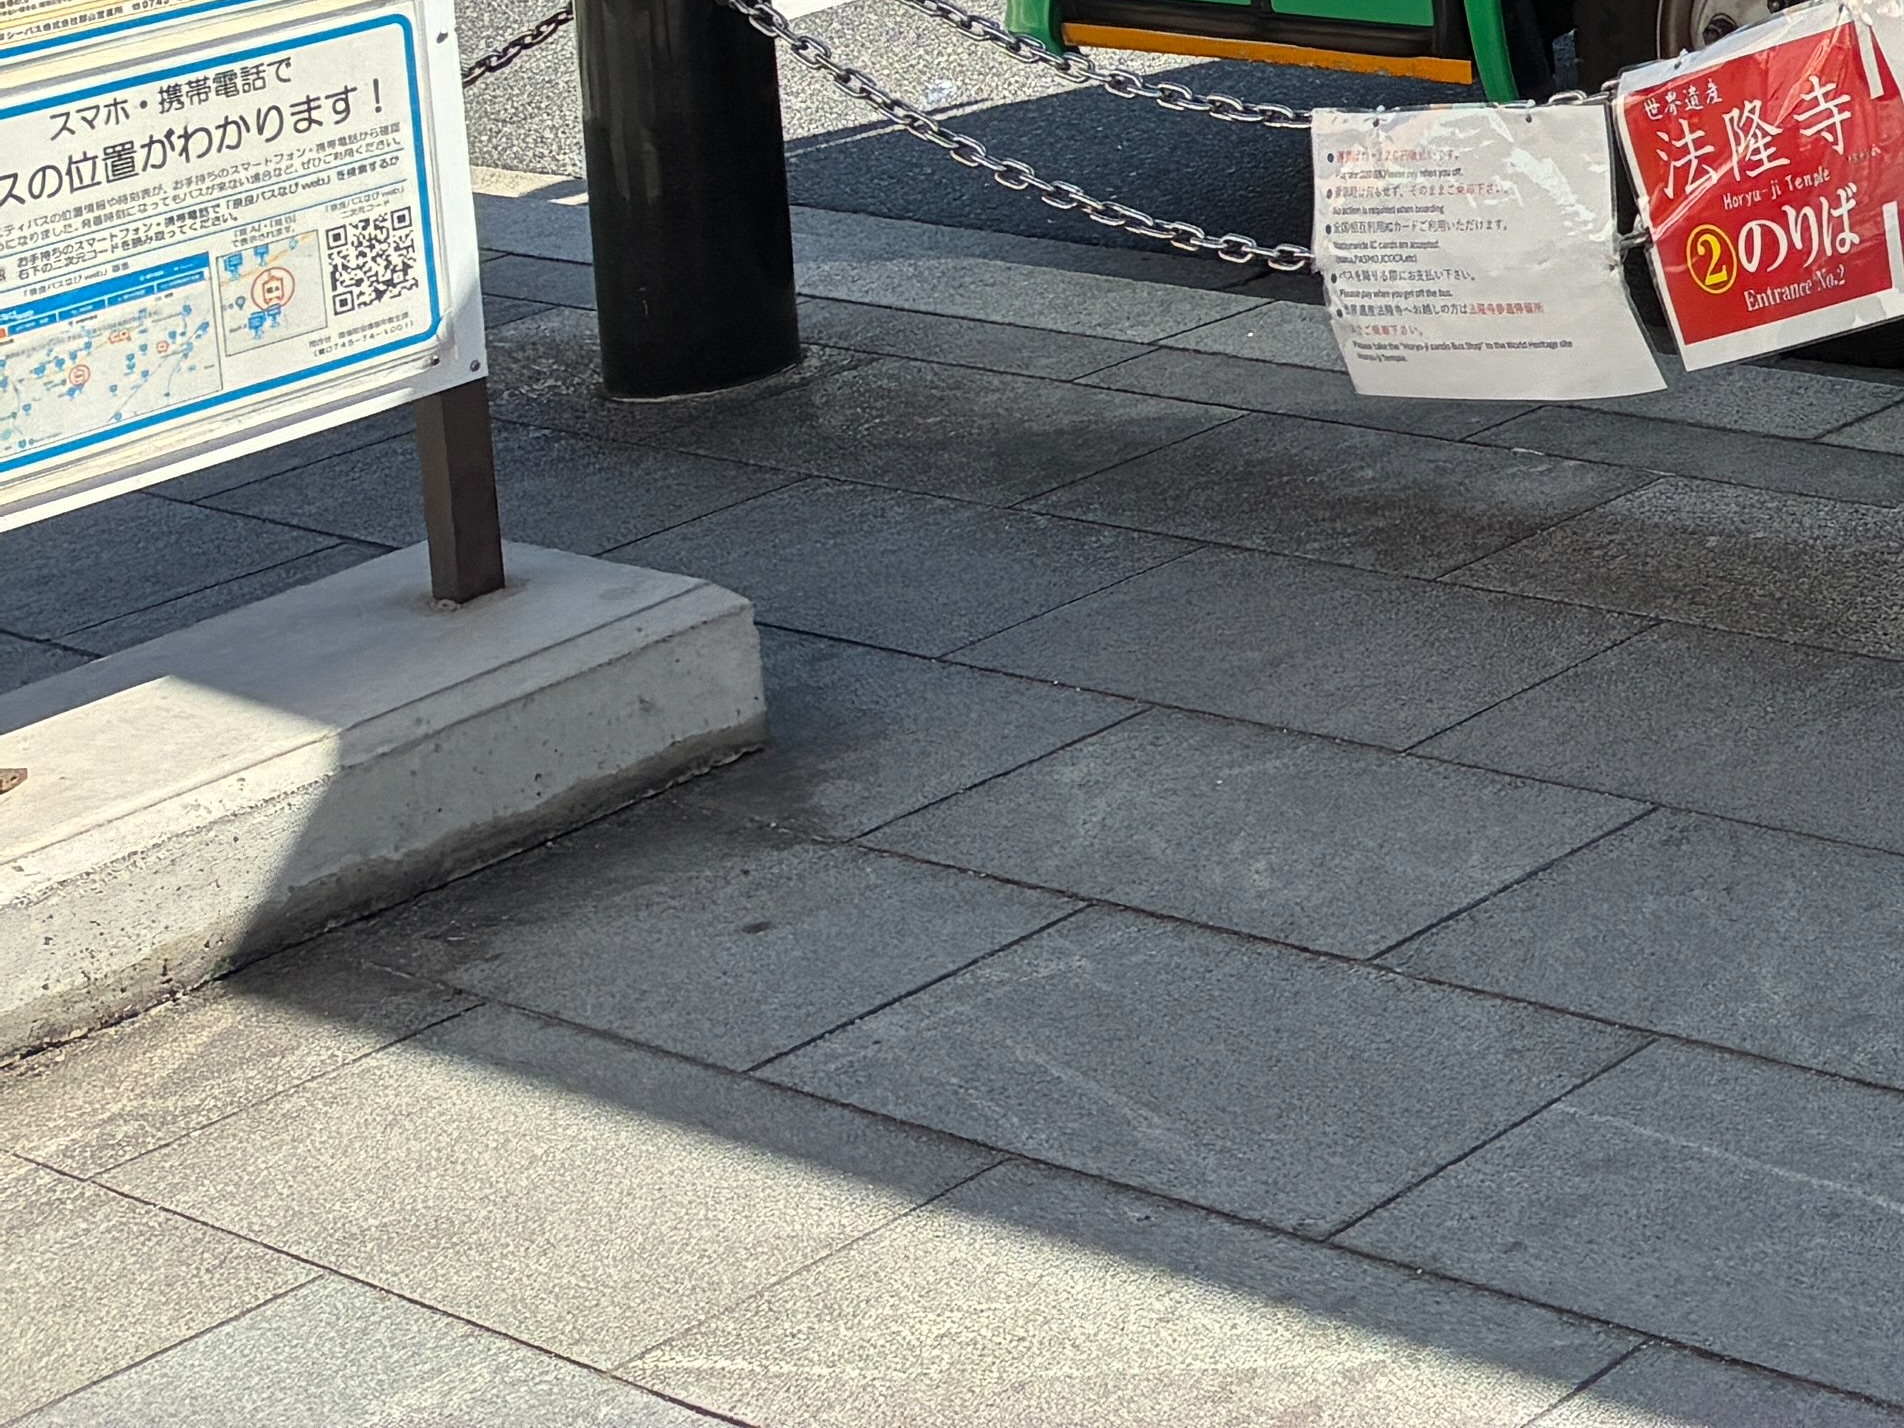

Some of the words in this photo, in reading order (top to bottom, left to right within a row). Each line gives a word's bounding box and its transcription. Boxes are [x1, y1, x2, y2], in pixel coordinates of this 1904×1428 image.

[49, 55, 292, 142] スマホ・携帯電話で
[1643, 78, 1723, 121] 世界遺産
[1656, 75, 1852, 200] 法隆寺
[1743, 277, 1813, 312] Entrance
[1815, 264, 1846, 291] No.2
